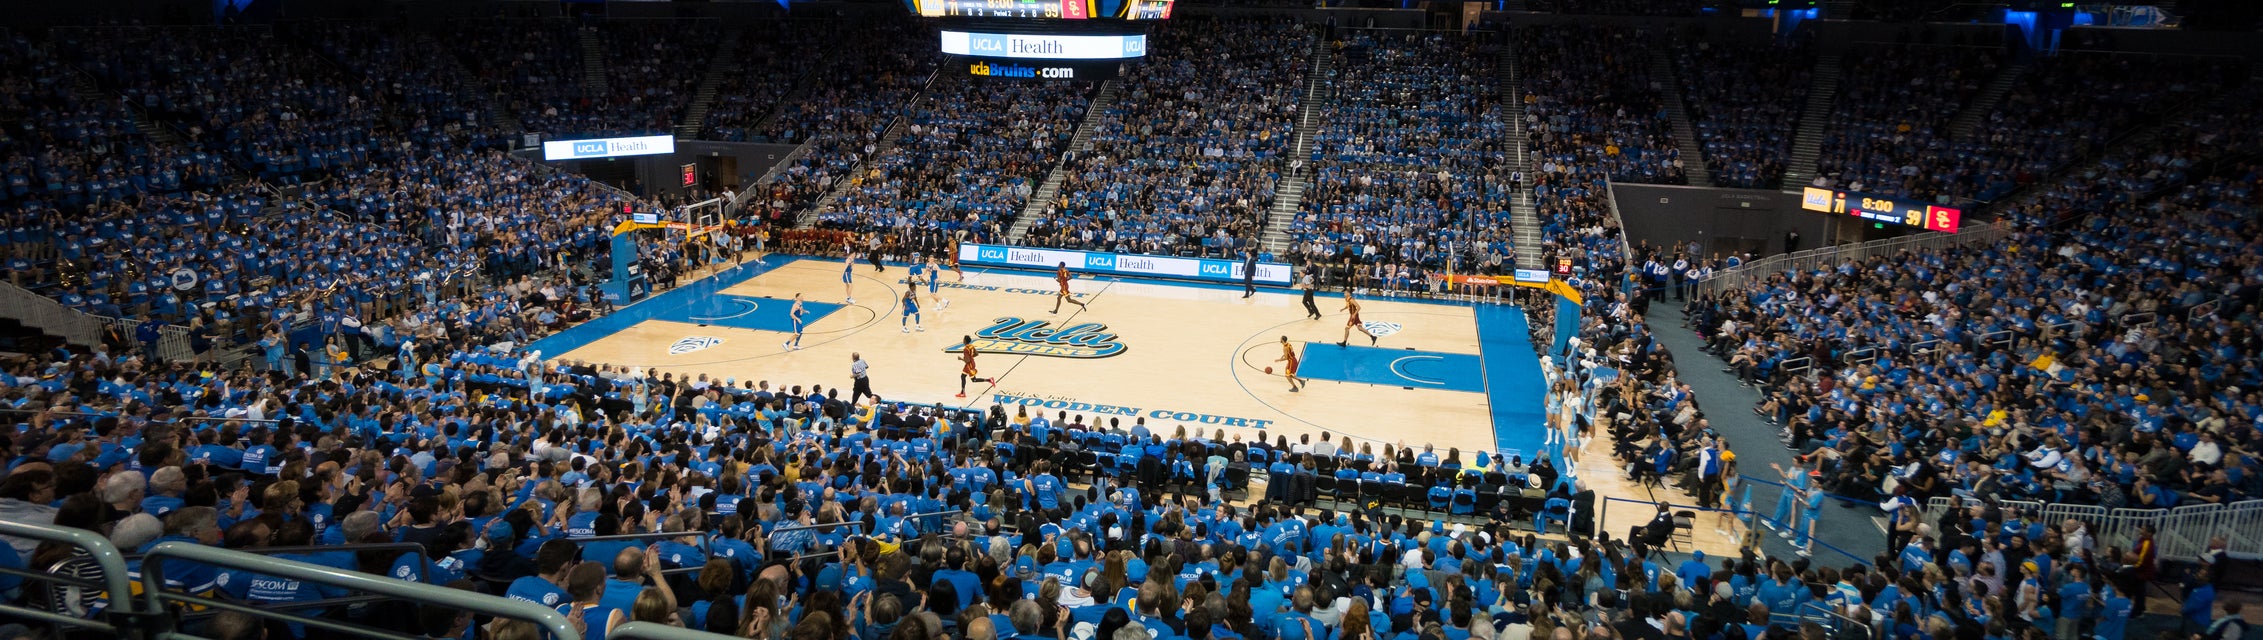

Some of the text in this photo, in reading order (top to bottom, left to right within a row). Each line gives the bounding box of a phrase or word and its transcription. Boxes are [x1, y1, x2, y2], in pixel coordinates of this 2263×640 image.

[967, 8, 983, 16] 8 3
[1021, 9, 1026, 17] 2
[1044, 3, 1059, 17] 59
[973, 39, 1064, 54] UCLA Health
[1125, 40, 1142, 52] UCLA
[577, 141, 648, 153] UCLA Health
[684, 173, 695, 185] 30
[1862, 198, 1894, 213] 8:00
[1905, 210, 1922, 226] 59
[981, 250, 1044, 263] UCLA Health
[1088, 257, 1154, 270] UCLA Health
[1559, 265, 1569, 273] 30
[1203, 264, 1271, 278] UCLA Hlth
[898, 280, 1001, 291] WODEN
[1005, 287, 1090, 297] COUT
[959, 340, 1098, 355] BRUINS
[993, 394, 1273, 429] WOODEN COURT
